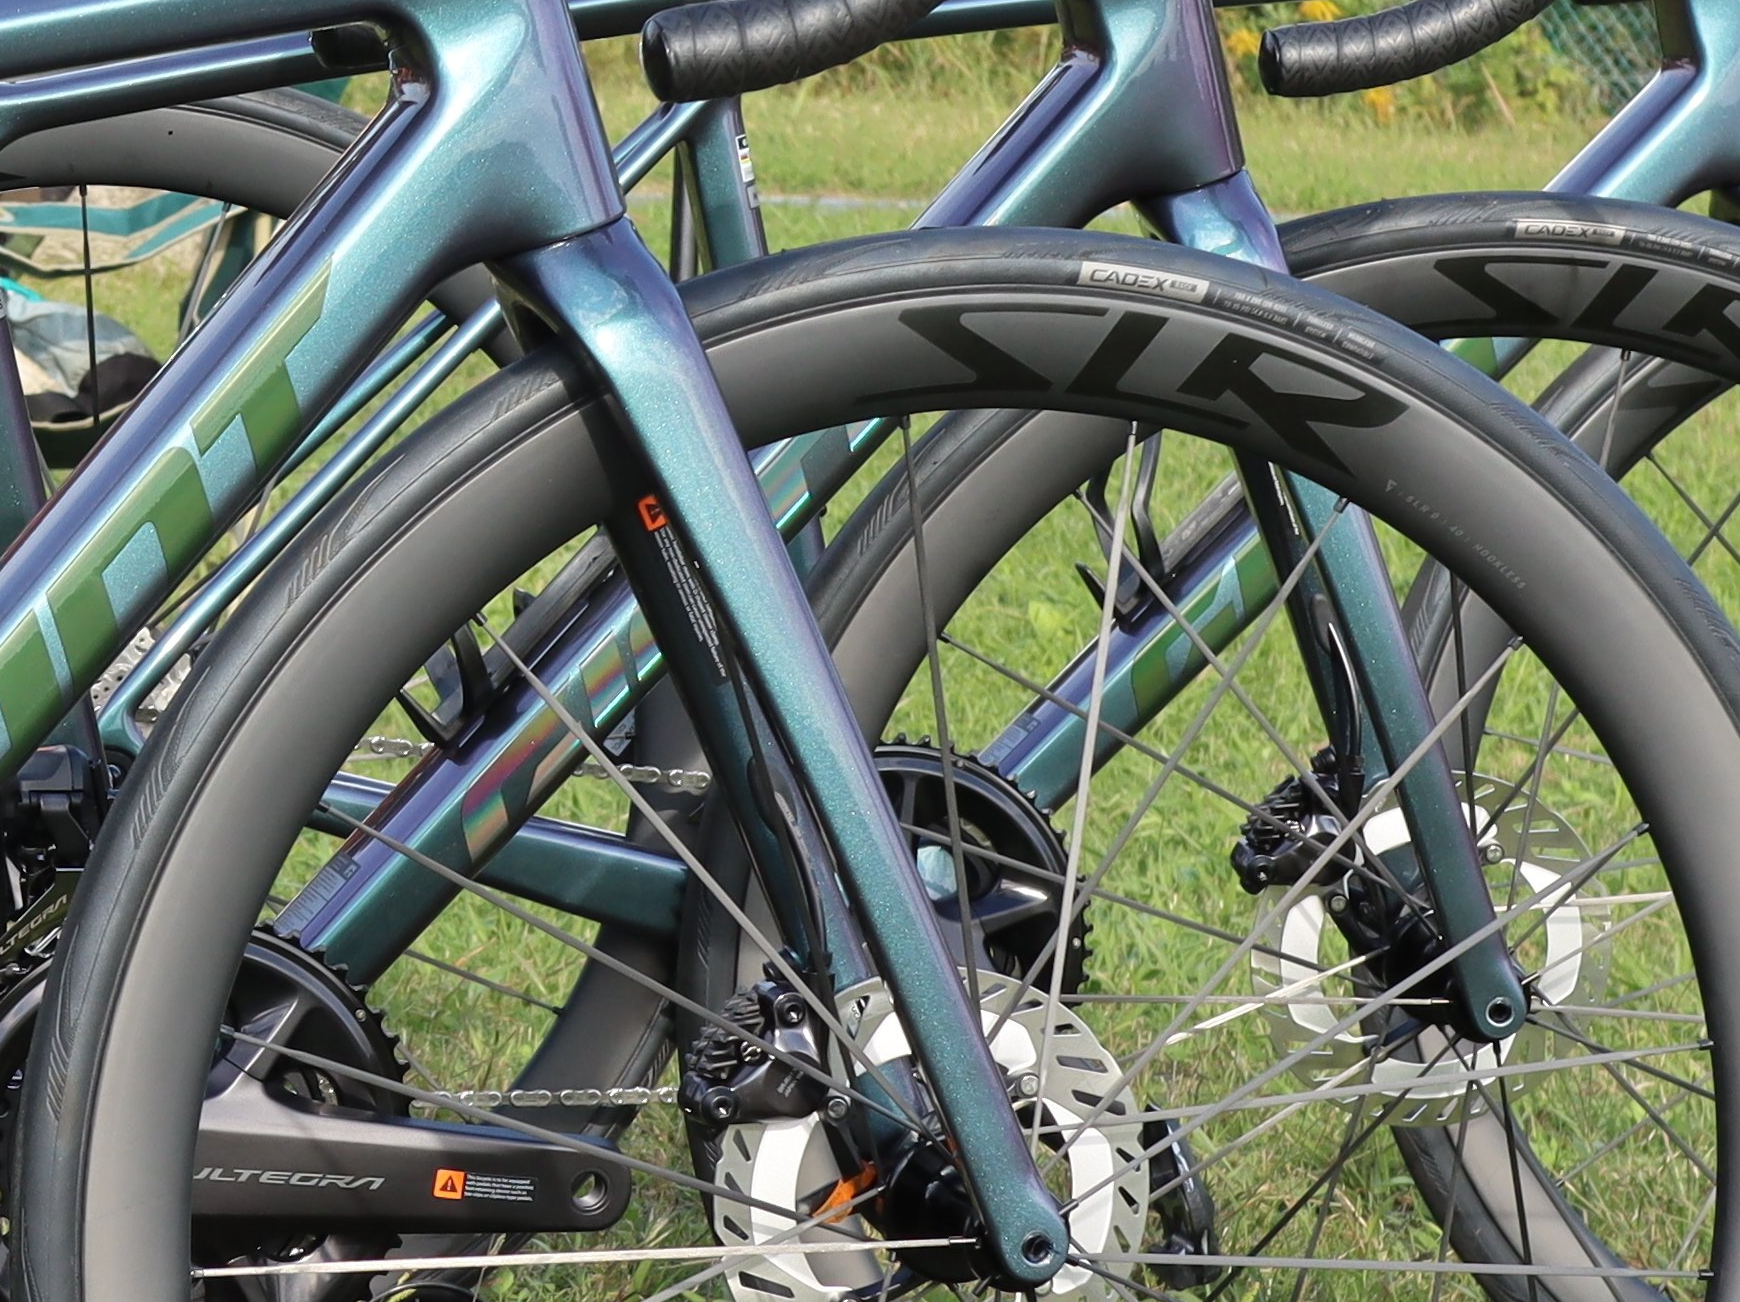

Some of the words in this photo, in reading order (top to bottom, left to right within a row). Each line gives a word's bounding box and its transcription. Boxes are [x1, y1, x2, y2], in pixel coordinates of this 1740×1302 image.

[1523, 224, 1592, 239] CADEX
[1088, 268, 1169, 292] CADEX
[853, 306, 1410, 480] SLR
[1472, 541, 1527, 590] HOOKLESS
